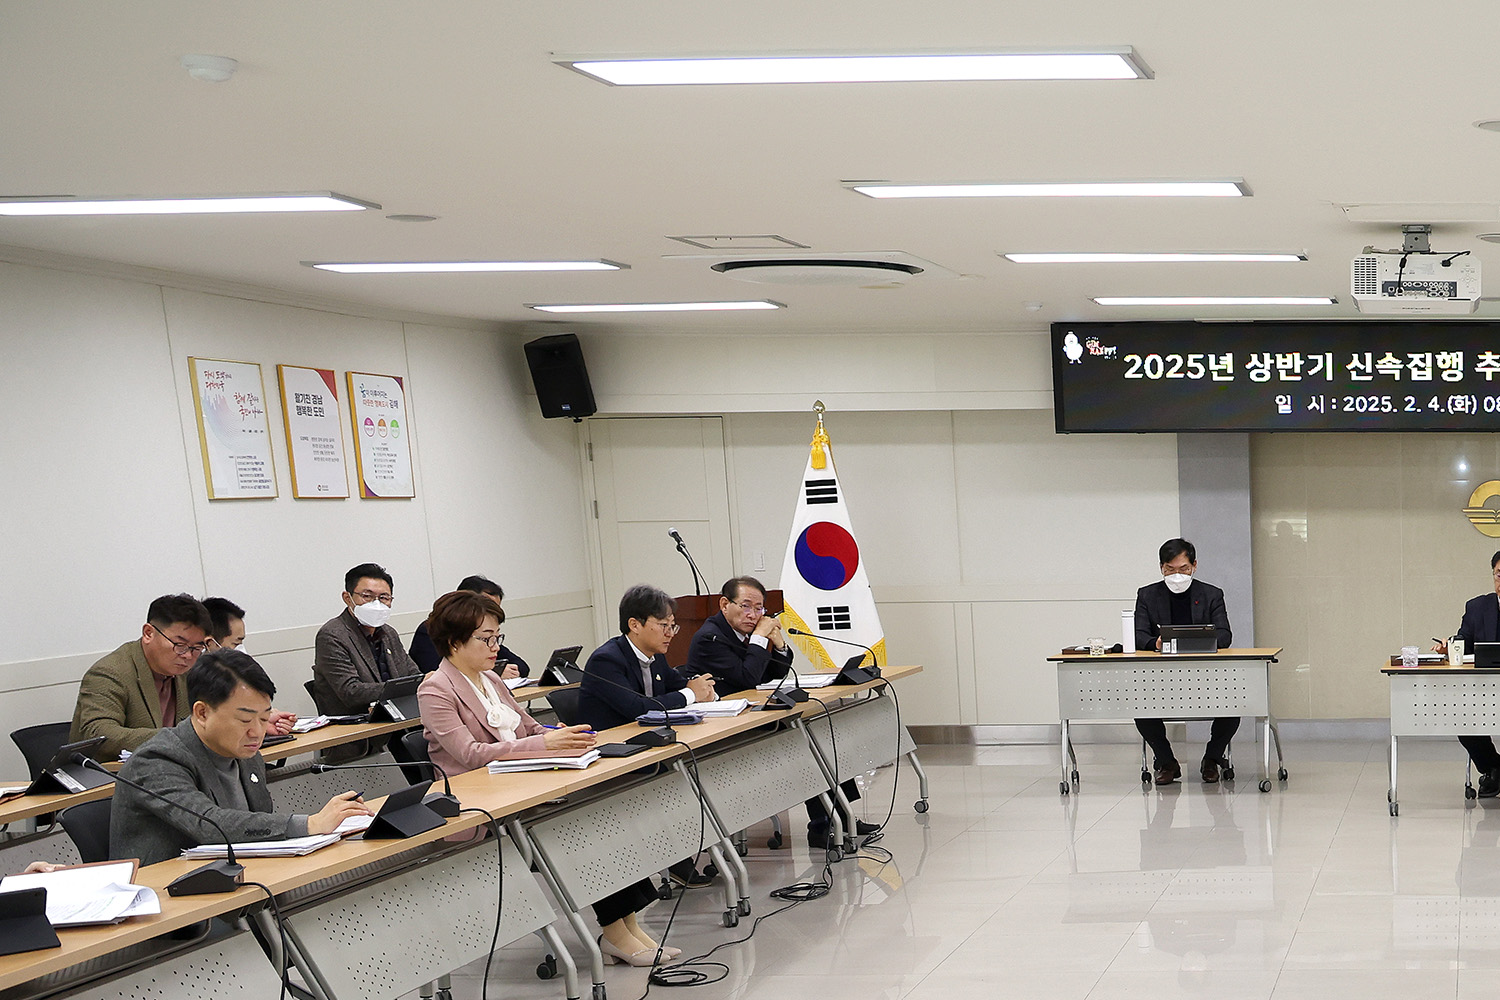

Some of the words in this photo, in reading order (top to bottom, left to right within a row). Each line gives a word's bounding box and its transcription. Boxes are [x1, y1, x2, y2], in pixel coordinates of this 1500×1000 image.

[1123, 352, 1235, 382] 2025년
[1245, 352, 1333, 383] 상반기
[1345, 351, 1464, 382] 신속집행
[1274, 394, 1293, 414] 일
[1342, 395, 1398, 413] 2025.
[1427, 394, 1478, 415] 4.(화)
